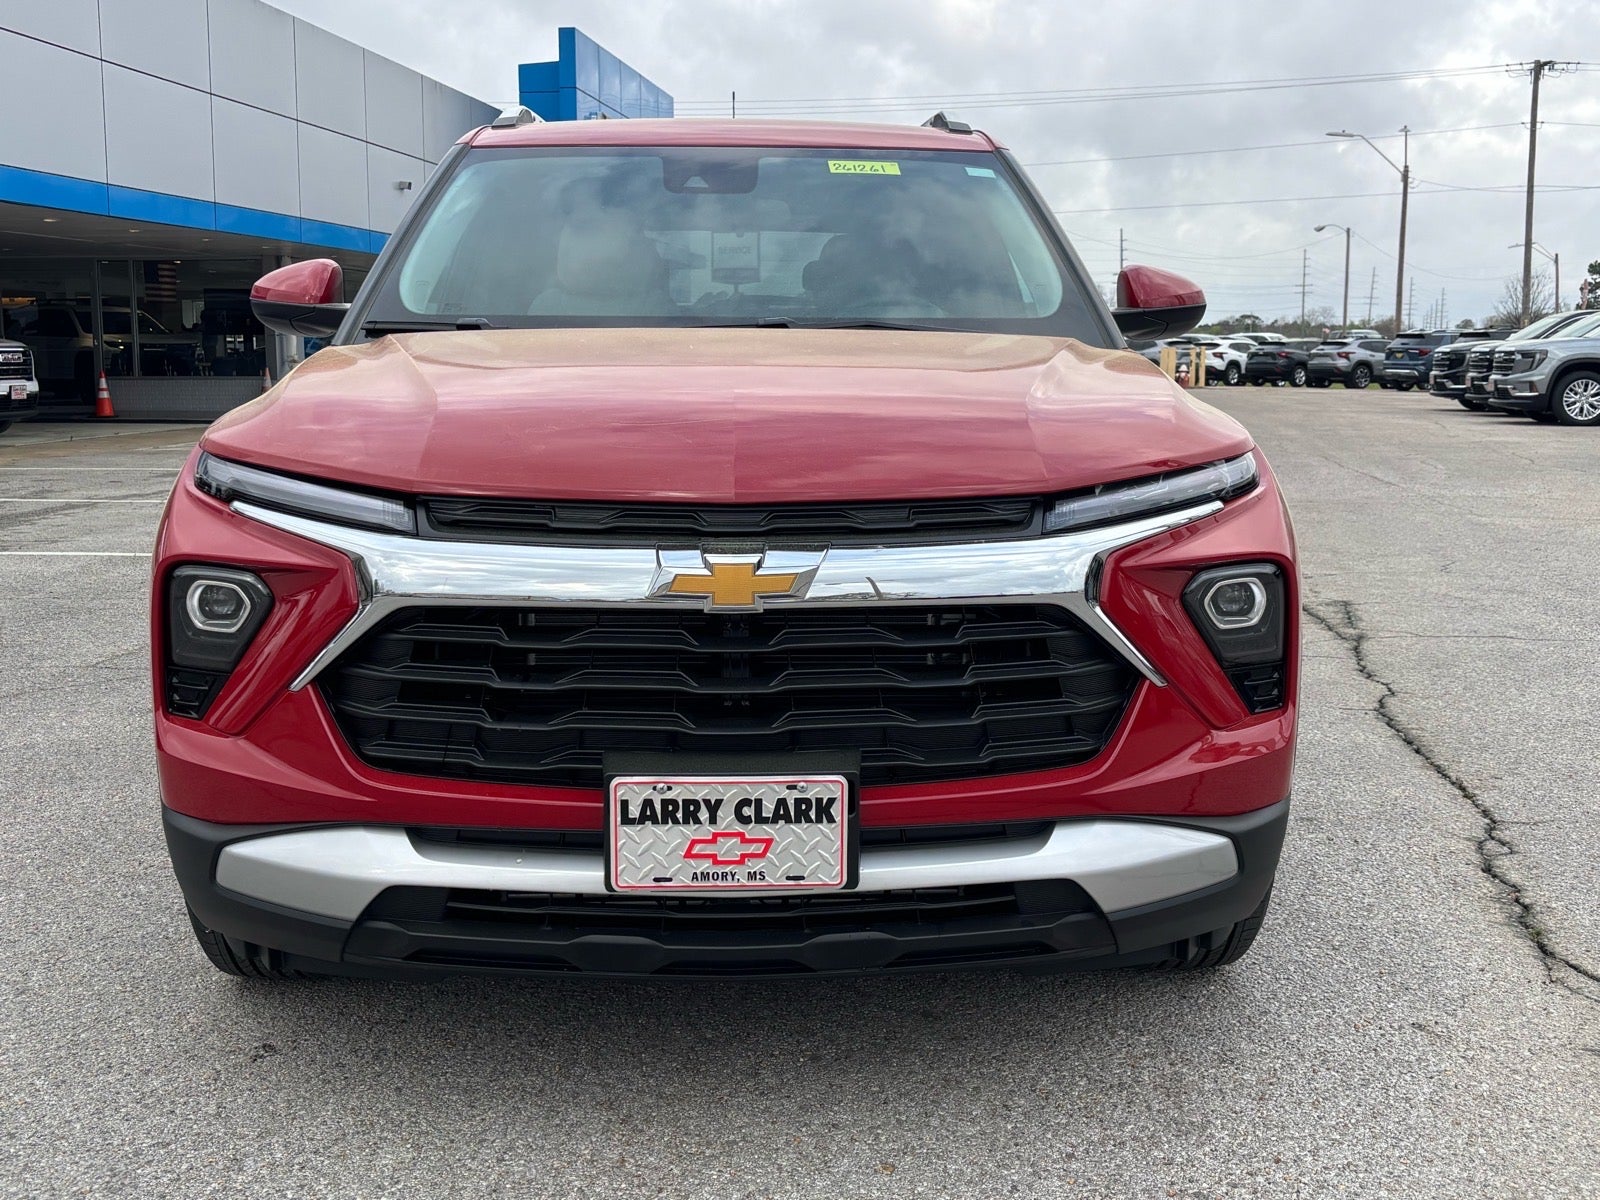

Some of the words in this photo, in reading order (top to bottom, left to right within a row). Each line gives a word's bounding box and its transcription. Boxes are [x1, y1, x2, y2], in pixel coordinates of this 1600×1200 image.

[620, 797, 724, 826] LARRY
[733, 796, 838, 825] CLARK
[691, 871, 740, 884] AMORY,
[747, 870, 767, 882] MS
